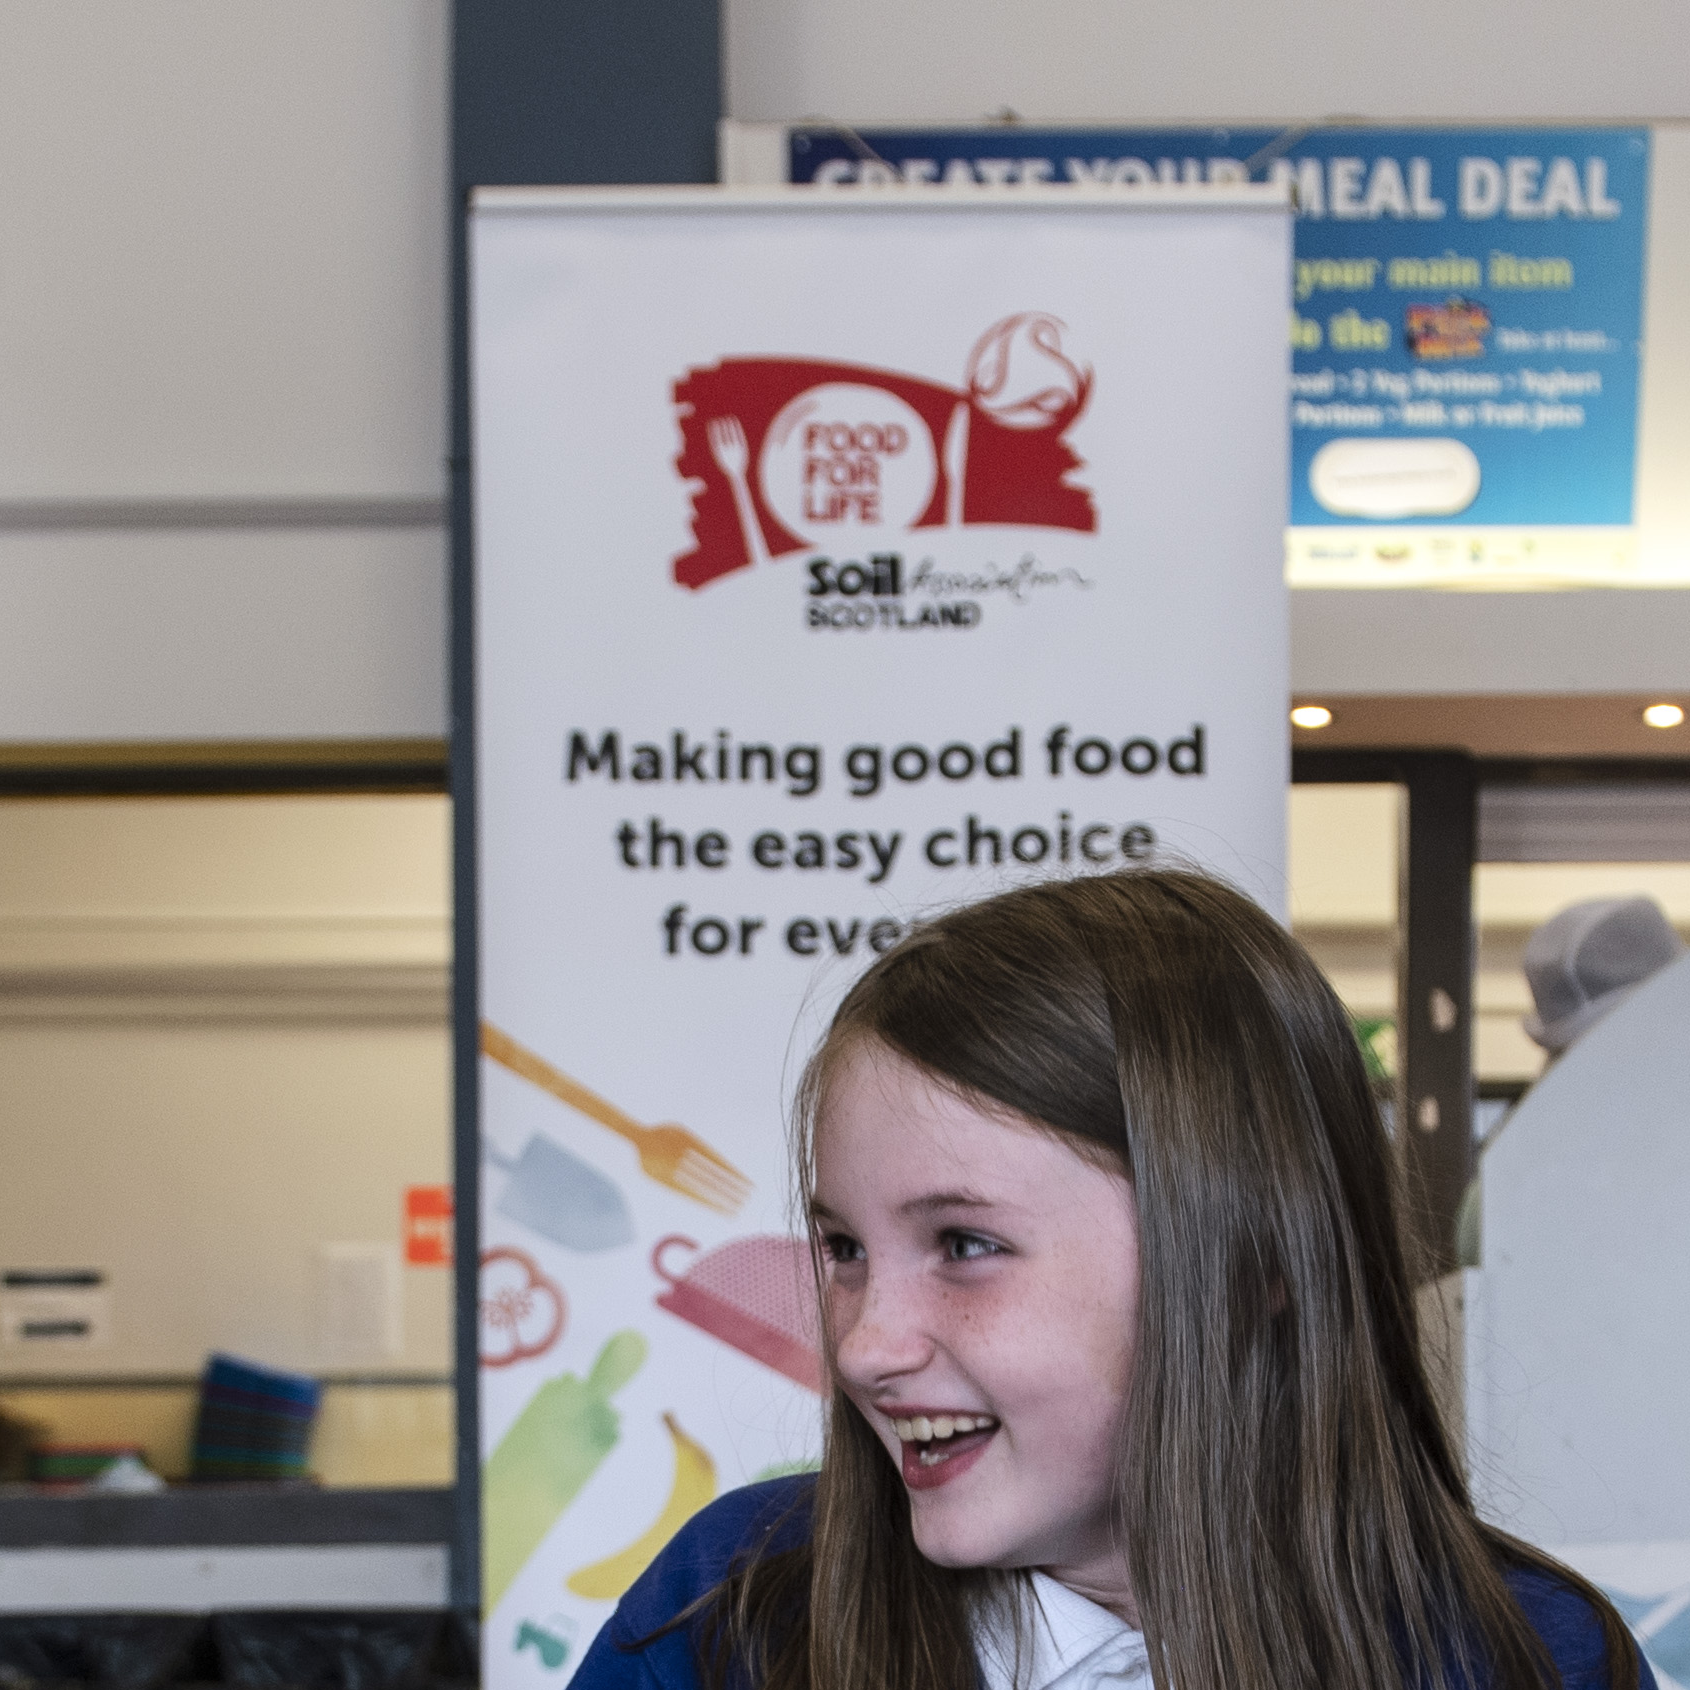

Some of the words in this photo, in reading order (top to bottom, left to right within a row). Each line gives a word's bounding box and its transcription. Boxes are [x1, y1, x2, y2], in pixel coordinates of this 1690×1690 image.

[1460, 156, 1622, 221] DEAL
[1387, 249, 1483, 292] main
[804, 421, 909, 456] FOOD
[804, 455, 881, 487] FOR
[803, 490, 882, 525] LIFE
[804, 601, 983, 631] SCOTLAND
[565, 728, 823, 795] Making
[845, 726, 1024, 796] good
[1045, 723, 1209, 778] food
[617, 818, 731, 872] the
[751, 829, 904, 883] easy
[925, 812, 1159, 872] choice
[663, 901, 765, 956] for
